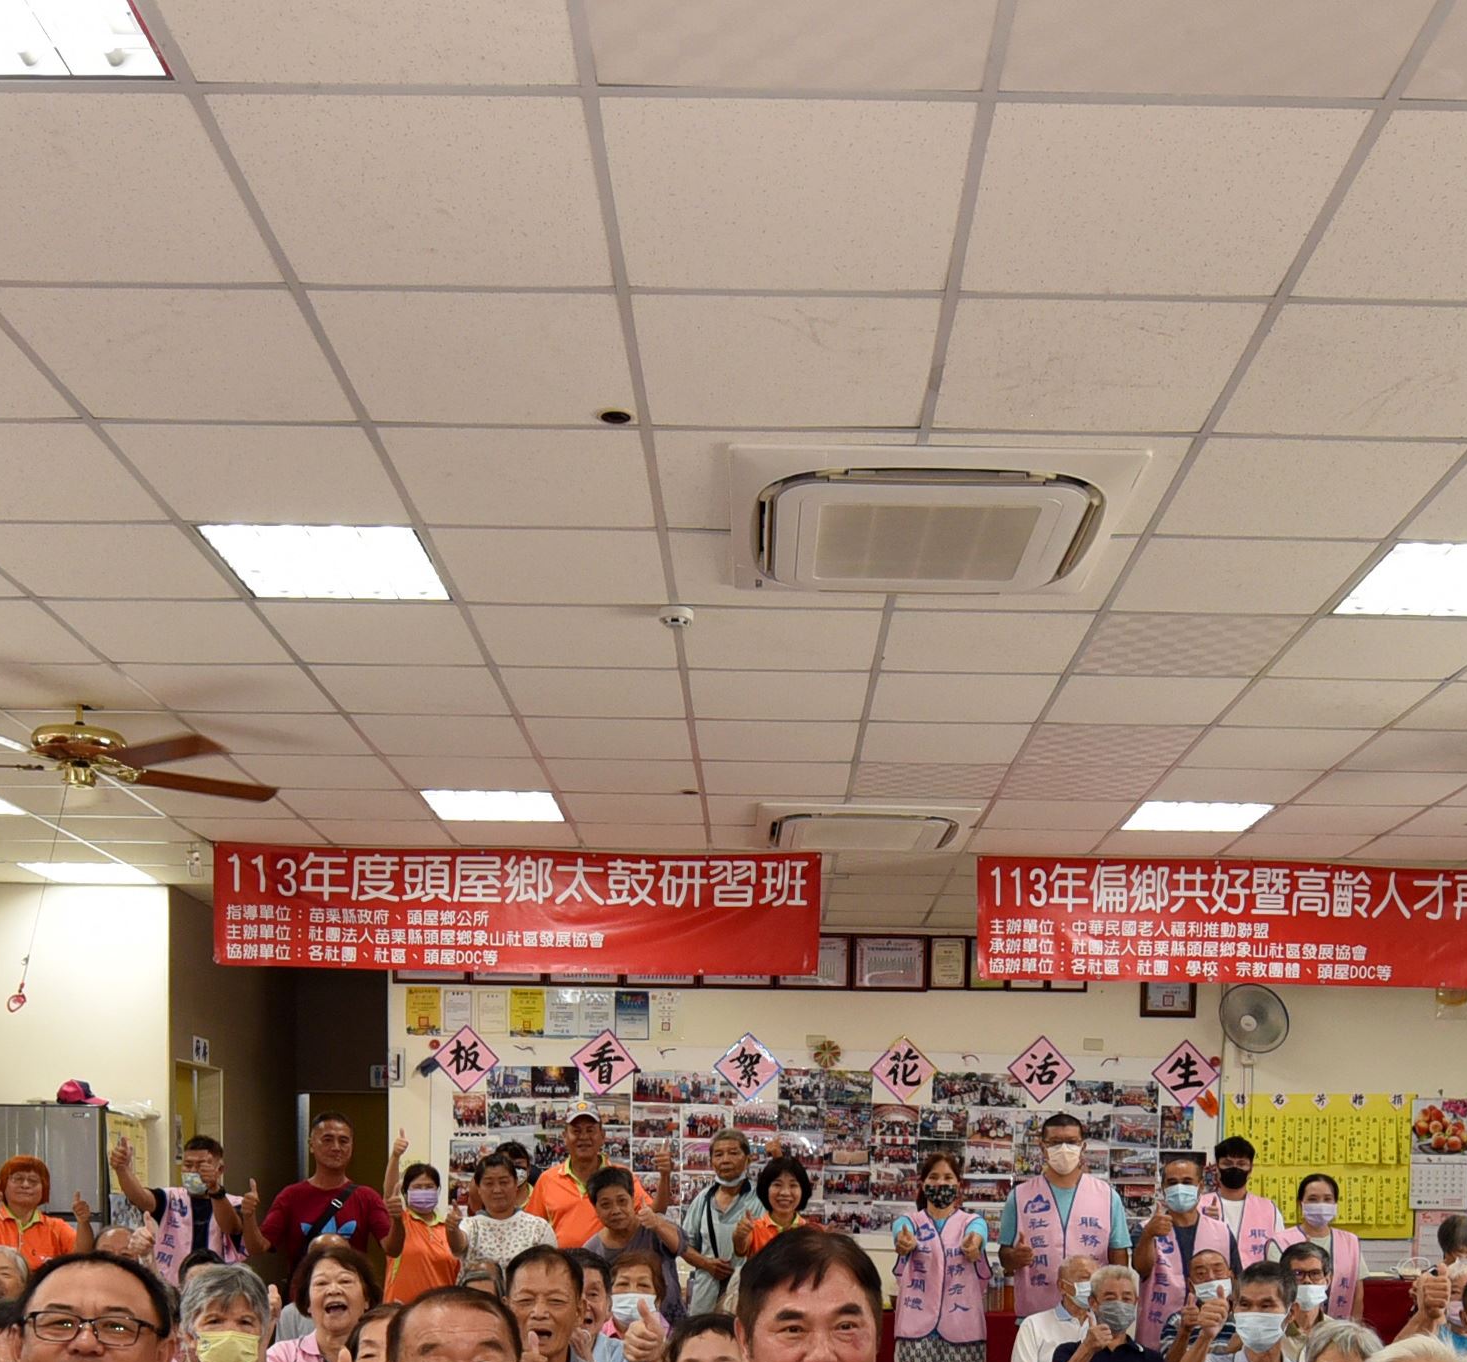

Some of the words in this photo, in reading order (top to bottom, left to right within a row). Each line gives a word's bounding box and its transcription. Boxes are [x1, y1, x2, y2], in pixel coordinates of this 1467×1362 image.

[227, 851, 809, 908] 113年度頭屋鄉太鼓研習班
